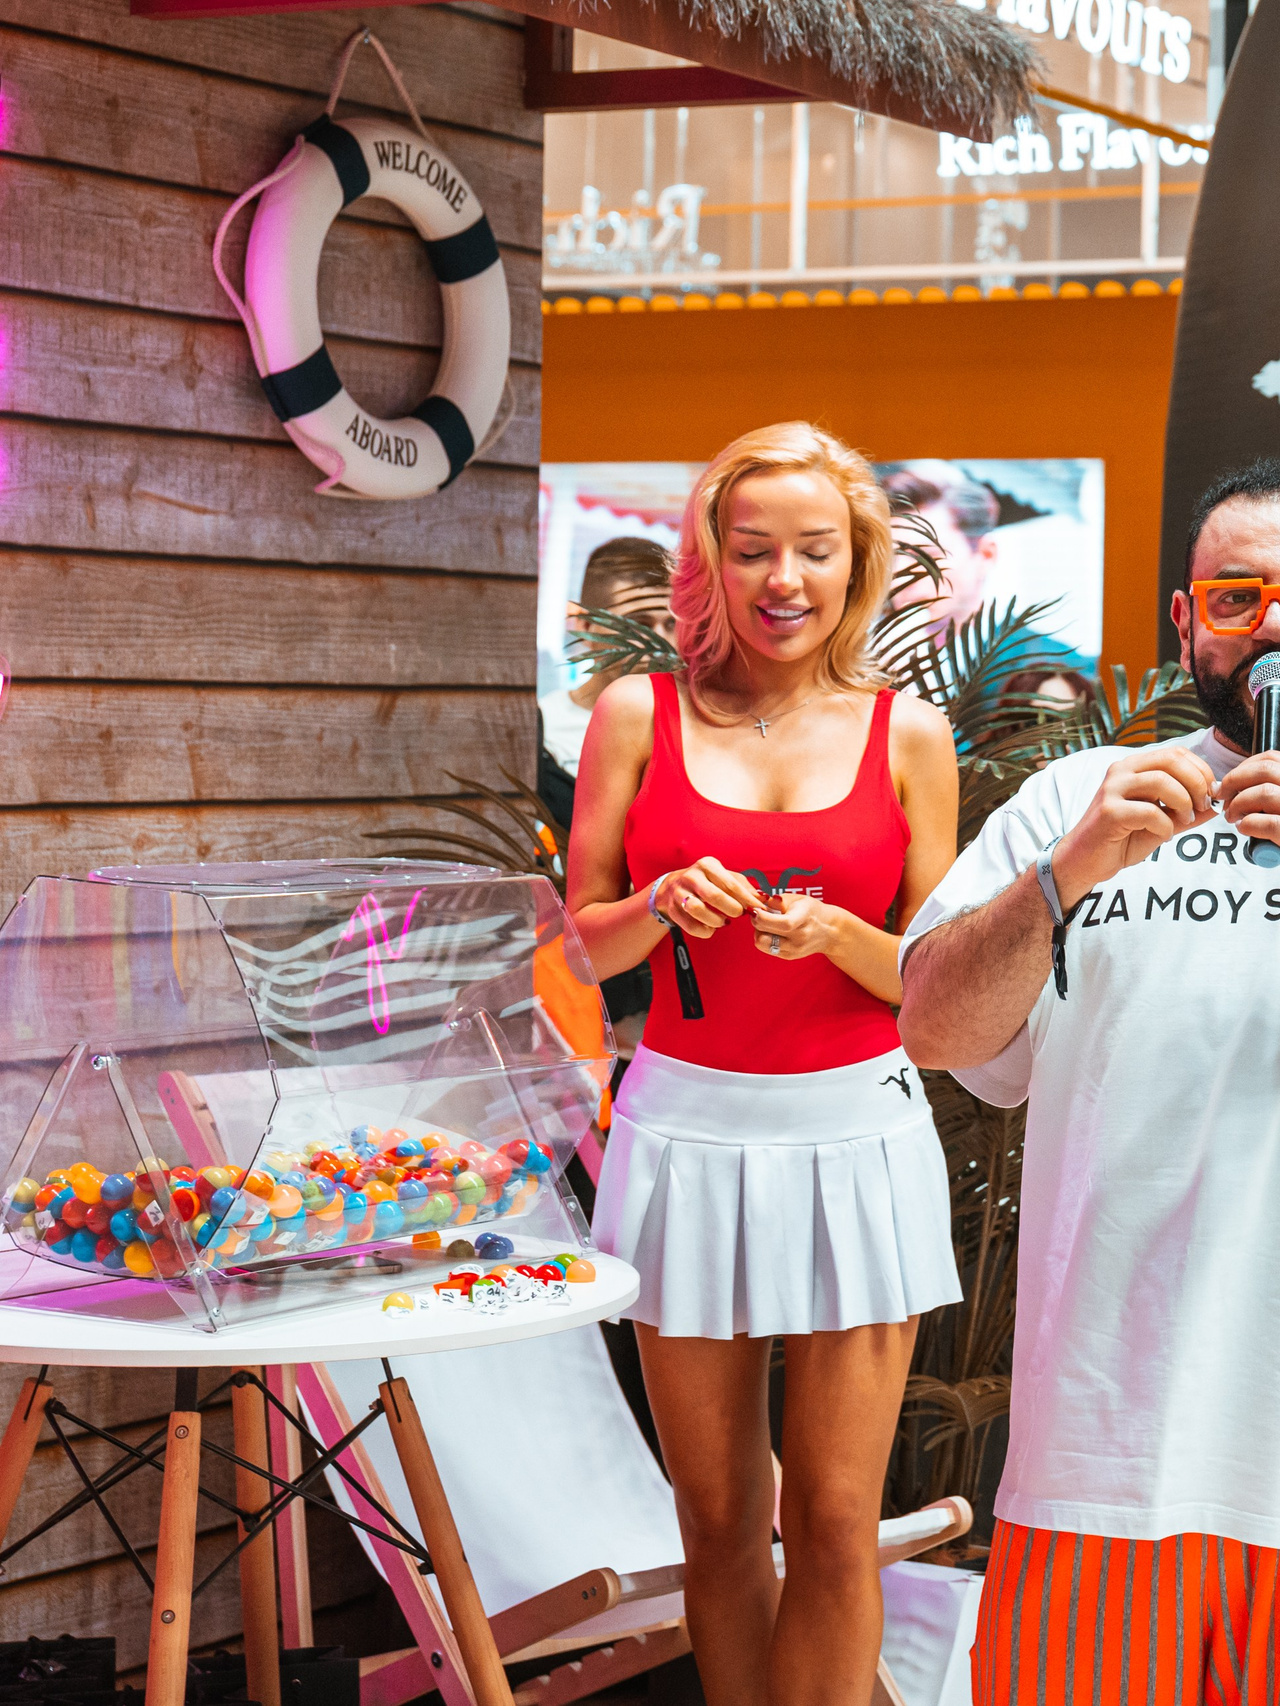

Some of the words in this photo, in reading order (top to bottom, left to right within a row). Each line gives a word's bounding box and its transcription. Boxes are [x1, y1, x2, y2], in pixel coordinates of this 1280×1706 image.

[957, 0, 1192, 83] avours
[374, 140, 468, 214] WELCOME
[345, 414, 418, 468] ABOARD
[1145, 886, 1253, 924] MOY
